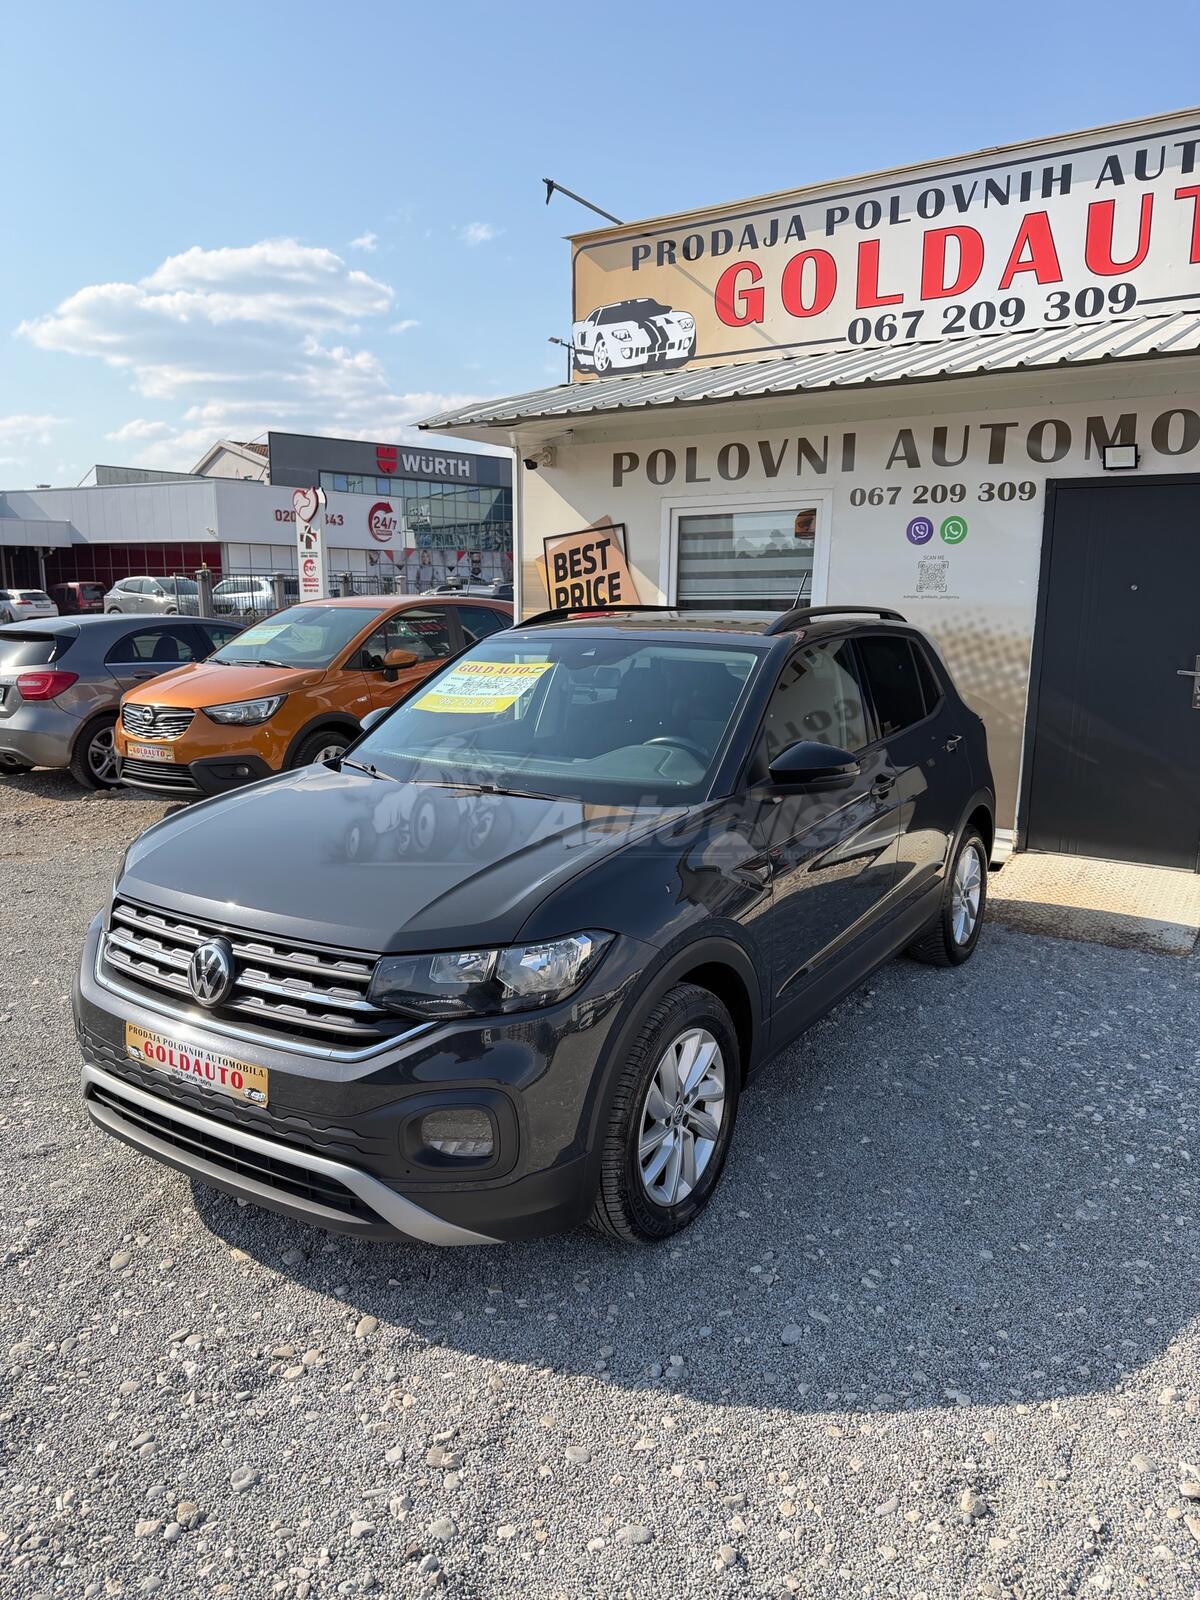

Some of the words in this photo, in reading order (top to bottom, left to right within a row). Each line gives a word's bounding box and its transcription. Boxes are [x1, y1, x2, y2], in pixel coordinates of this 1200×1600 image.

[631, 215, 806, 271] PRODAJA
[825, 163, 1072, 236] POLOVNIH
[847, 310, 925, 345] 067
[941, 297, 1026, 335] 209
[1043, 282, 1137, 322] 309
[402, 453, 470, 477] WÜRTH
[612, 432, 856, 487] POLOVNI
[850, 486, 902, 506] 067
[912, 483, 967, 505] 209
[977, 481, 1037, 502] 309
[374, 516, 397, 530] 24/7
[553, 538, 611, 583] BEST
[555, 571, 622, 609] PRICE
[458, 664, 495, 674] GOLD
[496, 665, 530, 675] AUTO
[128, 1025, 161, 1043] PRODAJA
[163, 1038, 203, 1058] POLOVNIH
[206, 1053, 264, 1078] AUTOMOBILA
[144, 1041, 244, 1090] GOLDAUTO
